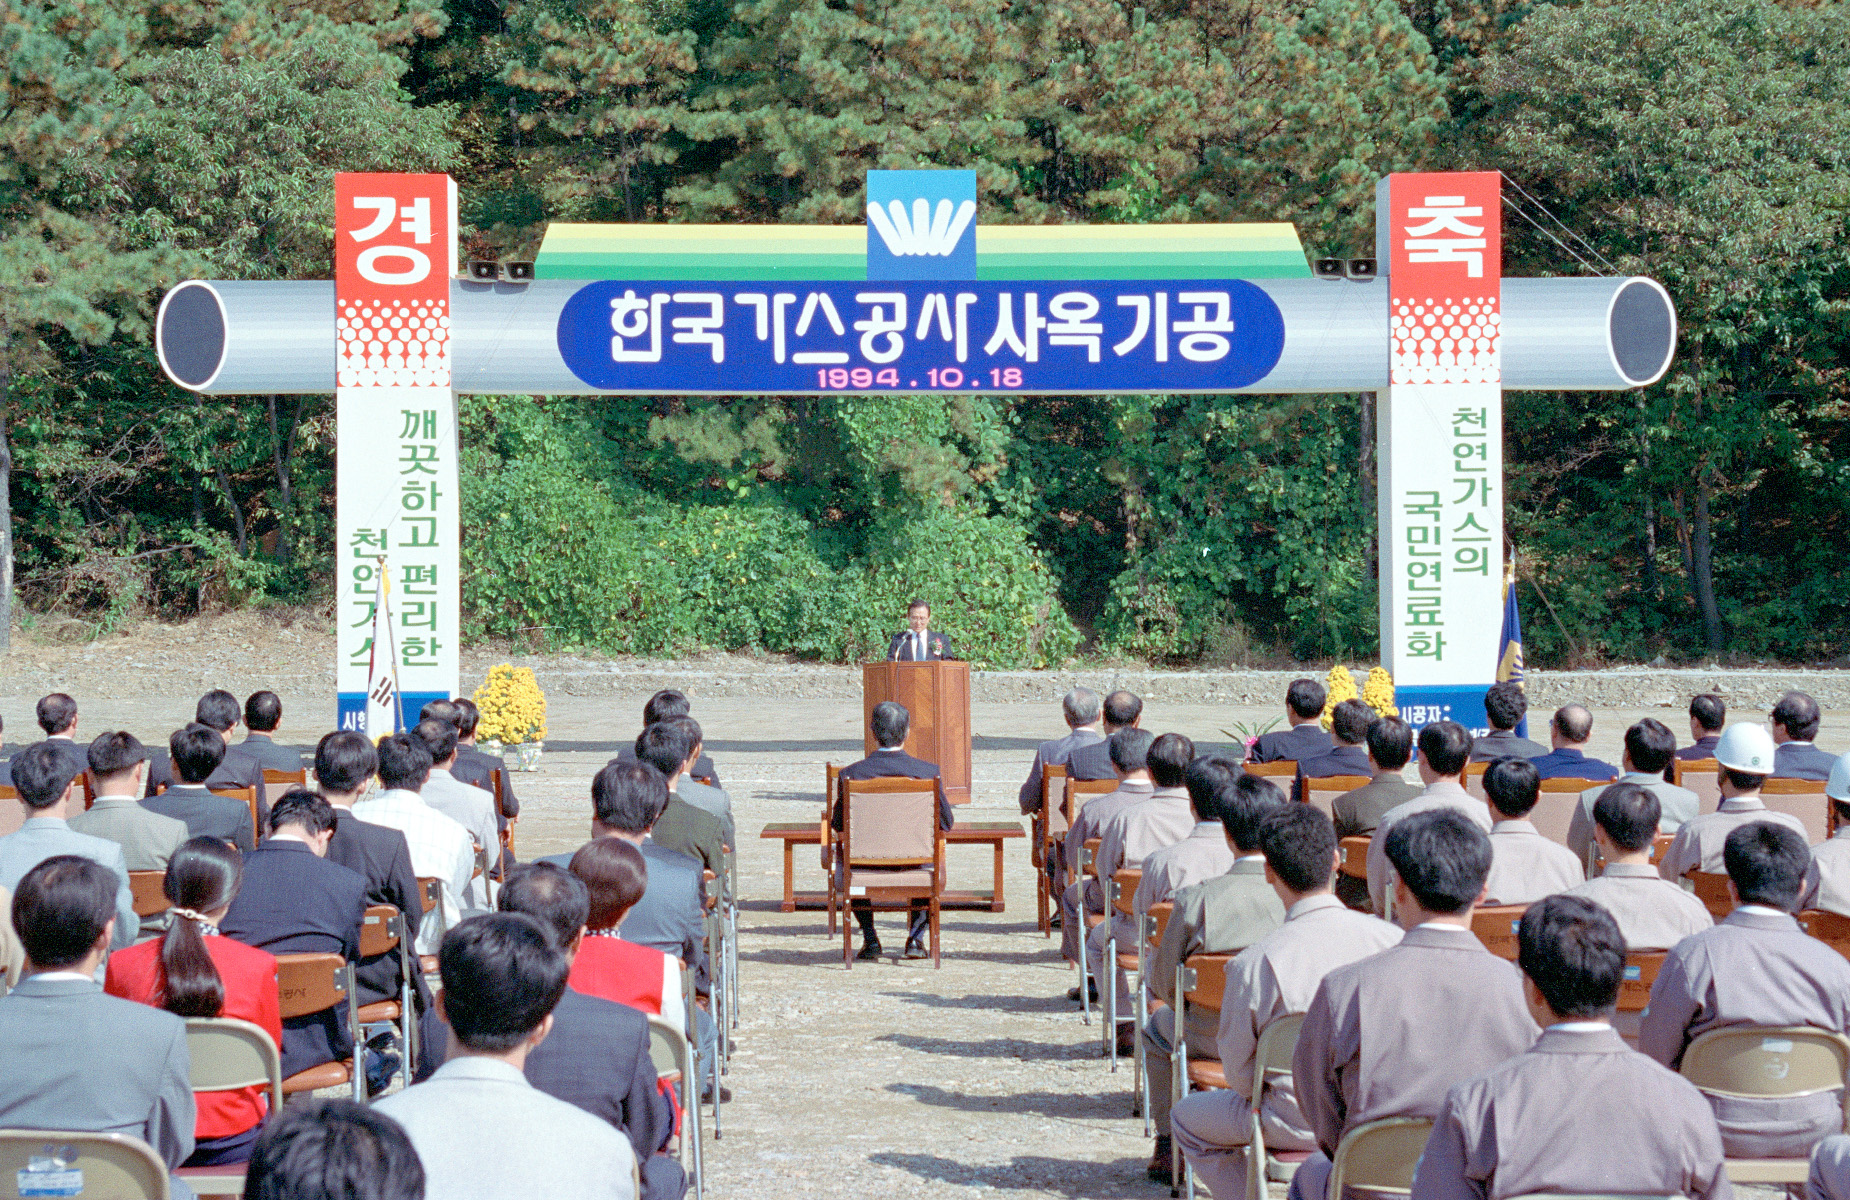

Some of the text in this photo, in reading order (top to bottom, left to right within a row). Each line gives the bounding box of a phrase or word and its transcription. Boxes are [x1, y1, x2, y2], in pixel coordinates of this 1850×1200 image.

[349, 197, 431, 285] 경
[1404, 196, 1486, 278] 축
[817, 368, 1023, 388] 1994.10.18
[398, 409, 442, 666] 깨끗하고 편리한
[1451, 407, 1492, 576] 천연가스의
[1403, 490, 1446, 661] 국민연료화
